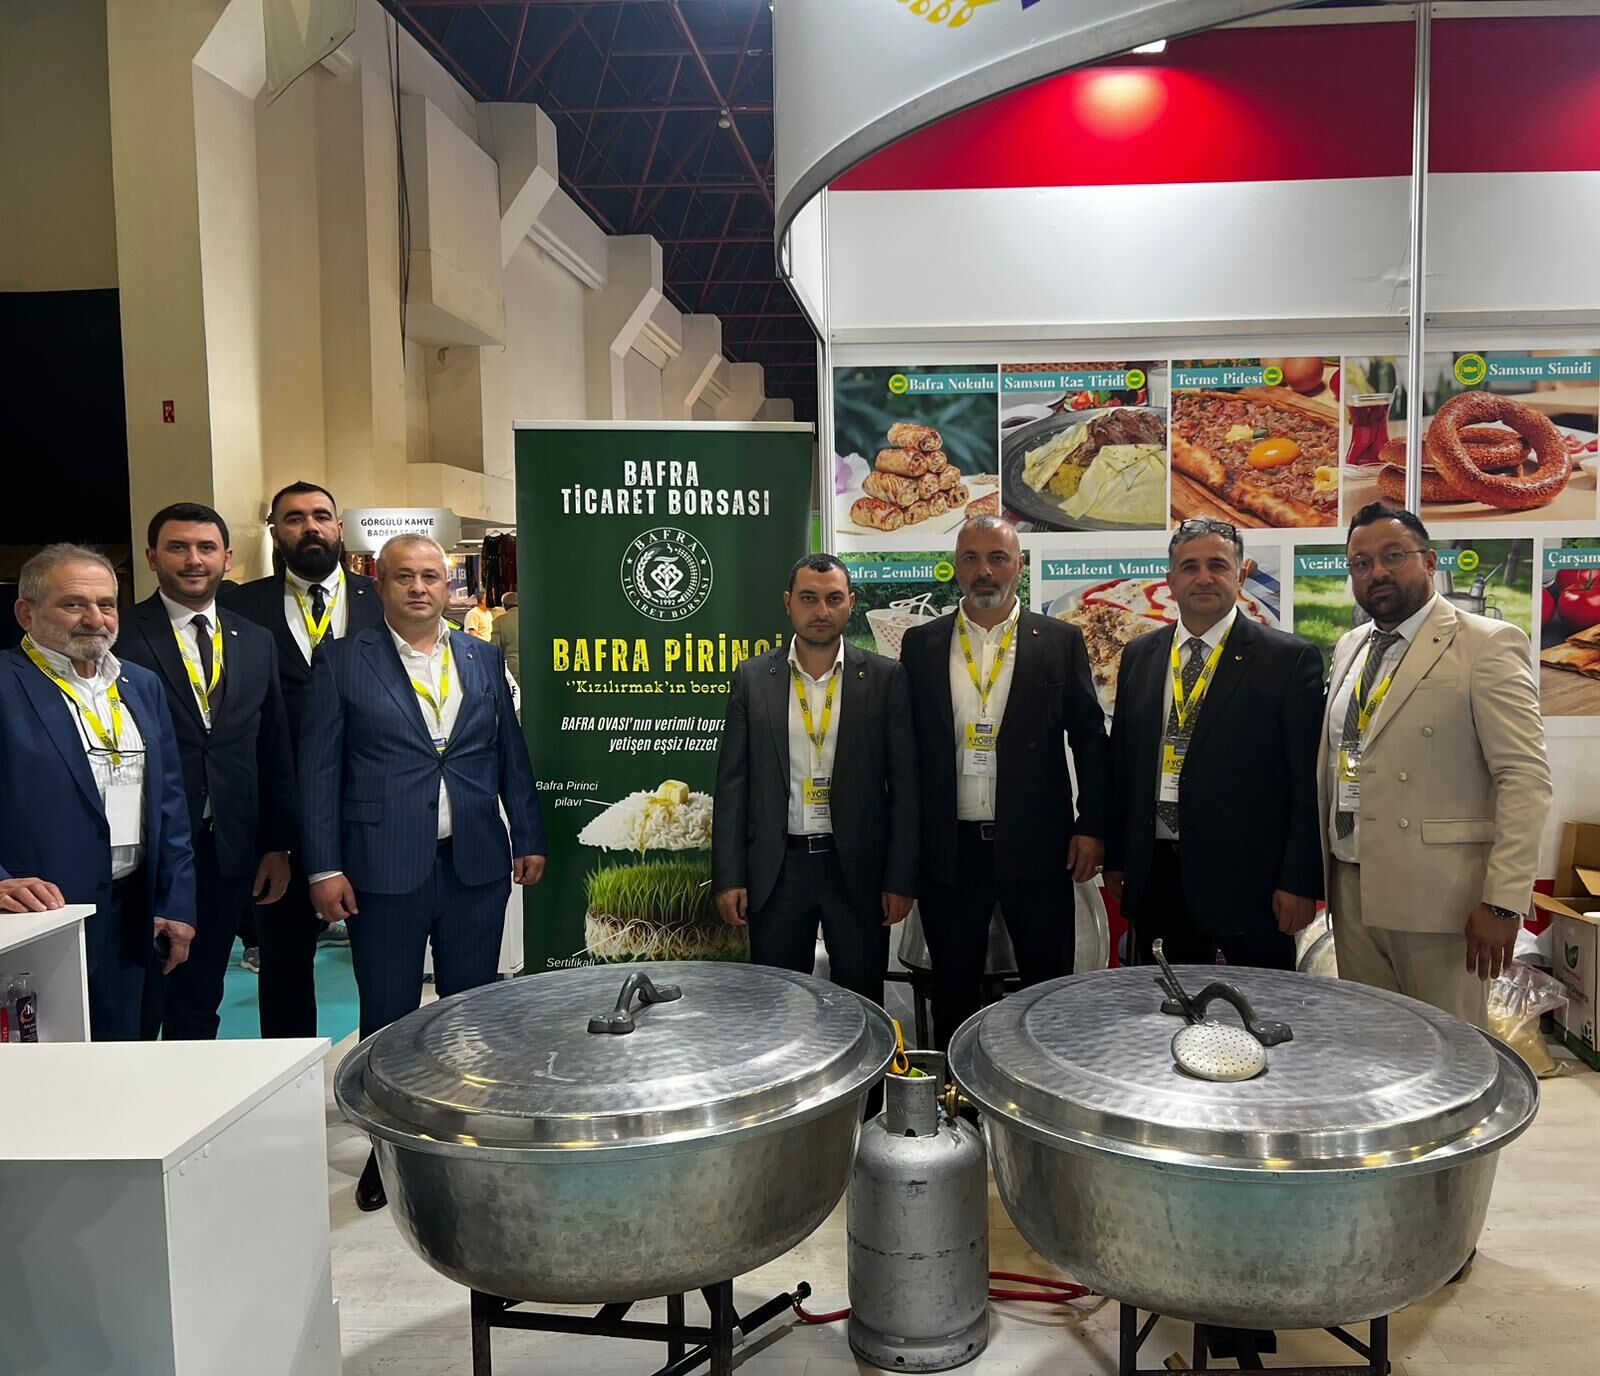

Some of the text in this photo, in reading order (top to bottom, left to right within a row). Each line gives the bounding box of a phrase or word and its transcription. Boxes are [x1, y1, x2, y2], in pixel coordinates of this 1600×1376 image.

[1489, 361, 1592, 376] Samsun Simidi
[909, 376, 994, 391] Bafra Nokulu
[1004, 374, 1125, 389] Samsun Kaz Tiridi
[1176, 371, 1262, 386] Terme Pidesi
[624, 460, 699, 487] BAFRA
[561, 484, 770, 516] TİCARET BORSASI
[360, 517, 435, 527] GÖRGÜLÜ KAHVE
[634, 529, 698, 552] BAFRA
[881, 565, 933, 579] Zembili
[1047, 562, 1169, 576] Yakakent Mantıs
[553, 638, 650, 672] BAFRA
[561, 716, 595, 731] BAFRA
[654, 716, 696, 731] verimli
[608, 736, 719, 755] yetişen eşsiz lezzet
[535, 780, 599, 791] Bafra Pirinci
[554, 796, 582, 809] pilavı
